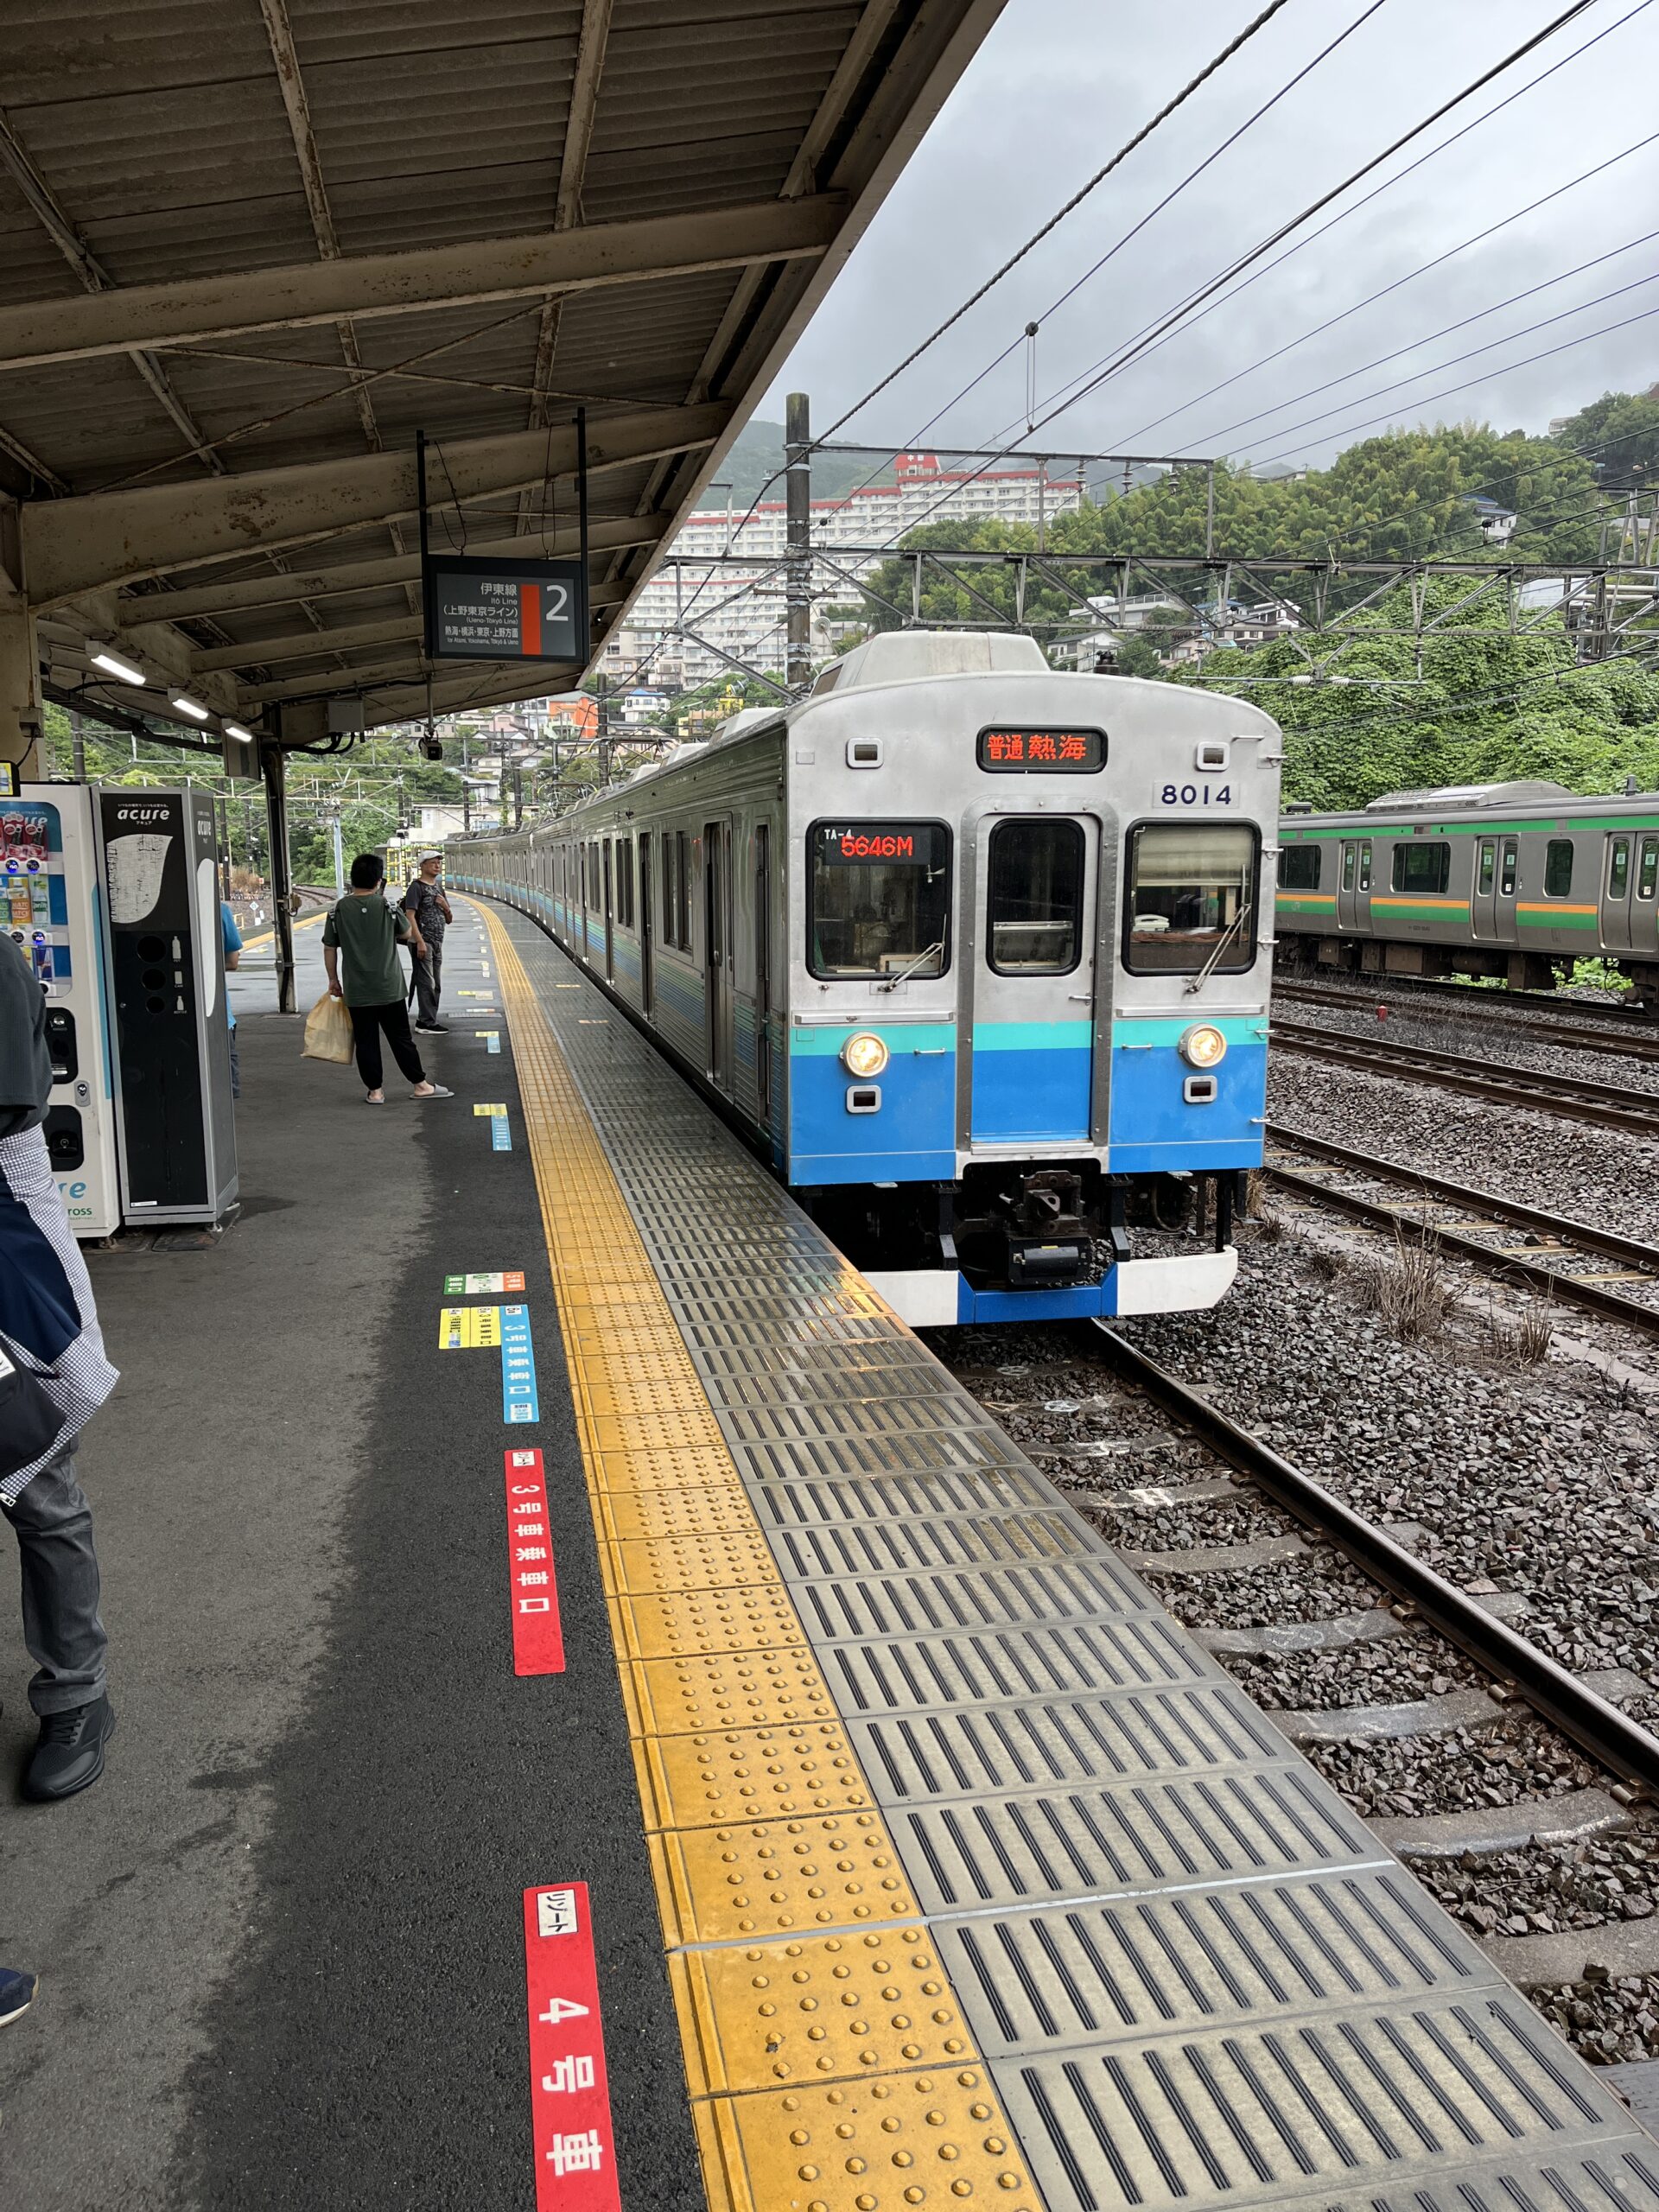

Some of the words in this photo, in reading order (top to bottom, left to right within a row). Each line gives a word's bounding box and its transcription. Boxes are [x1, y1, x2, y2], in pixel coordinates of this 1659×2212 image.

[480, 582, 518, 595] 伊東線
[546, 585, 569, 621] 2
[987, 735, 1024, 760] 普通
[1028, 735, 1087, 760] 熱海
[1161, 785, 1231, 805] 8014
[117, 810, 170, 820] acure
[824, 829, 853, 840] TA-4
[842, 836, 913, 857] 5646M
[505, 1325, 531, 1395] 3号車乗車口
[512, 1484, 550, 1613] 3号車乗車口
[546, 1893, 569, 1932] リゾート
[538, 1998, 602, 2176] 4号車
